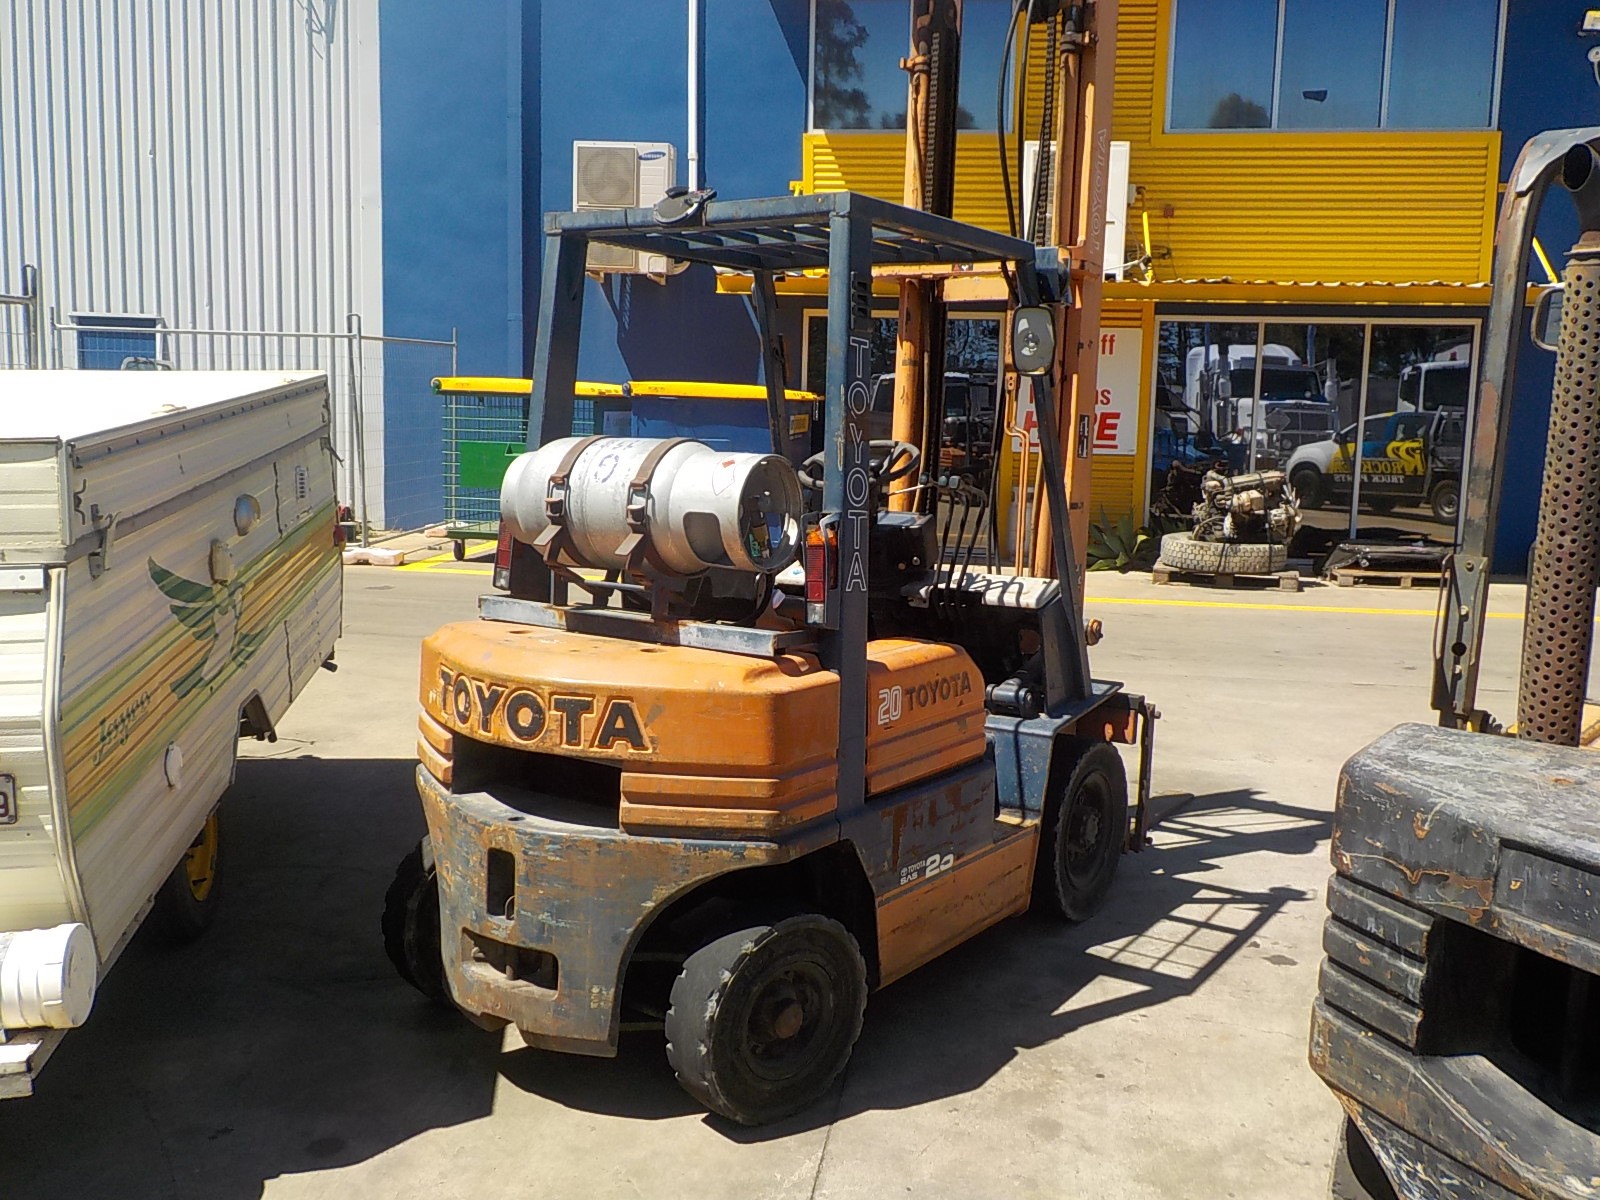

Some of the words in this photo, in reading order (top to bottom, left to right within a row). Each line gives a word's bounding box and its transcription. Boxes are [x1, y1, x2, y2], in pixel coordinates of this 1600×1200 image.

[846, 336, 870, 592] TOYOTA
[440, 664, 652, 752] TOYOTA
[877, 685, 902, 725] 20
[905, 671, 972, 711] TOYOTA
[908, 860, 926, 873] TOYOTA
